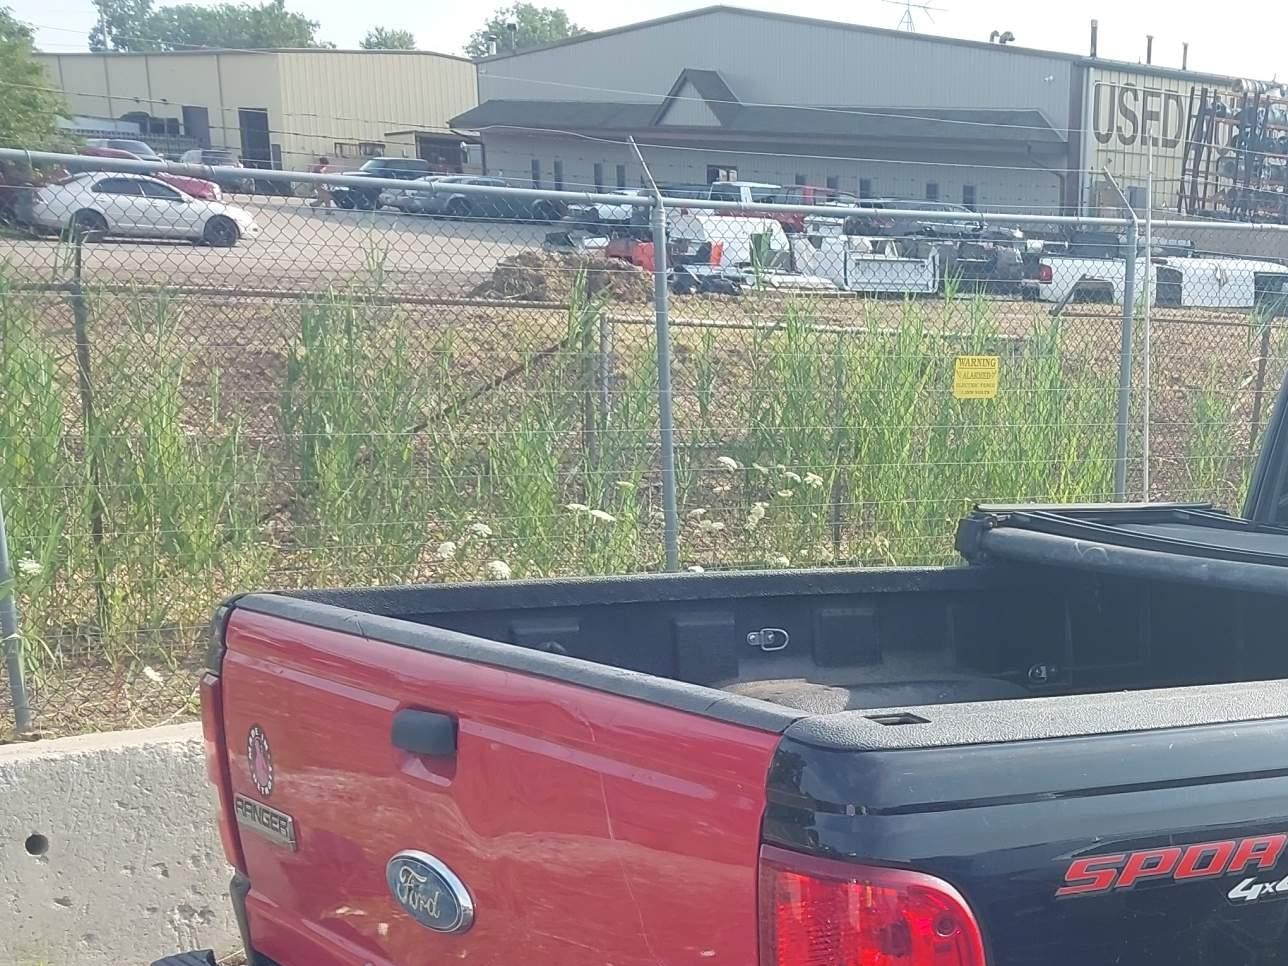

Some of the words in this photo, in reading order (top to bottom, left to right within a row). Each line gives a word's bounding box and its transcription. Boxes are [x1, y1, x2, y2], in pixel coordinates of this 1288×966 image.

[1093, 80, 1184, 148] USED
[958, 357, 997, 368] WARNING
[235, 796, 289, 838] RANGER
[397, 865, 441, 919] Ford
